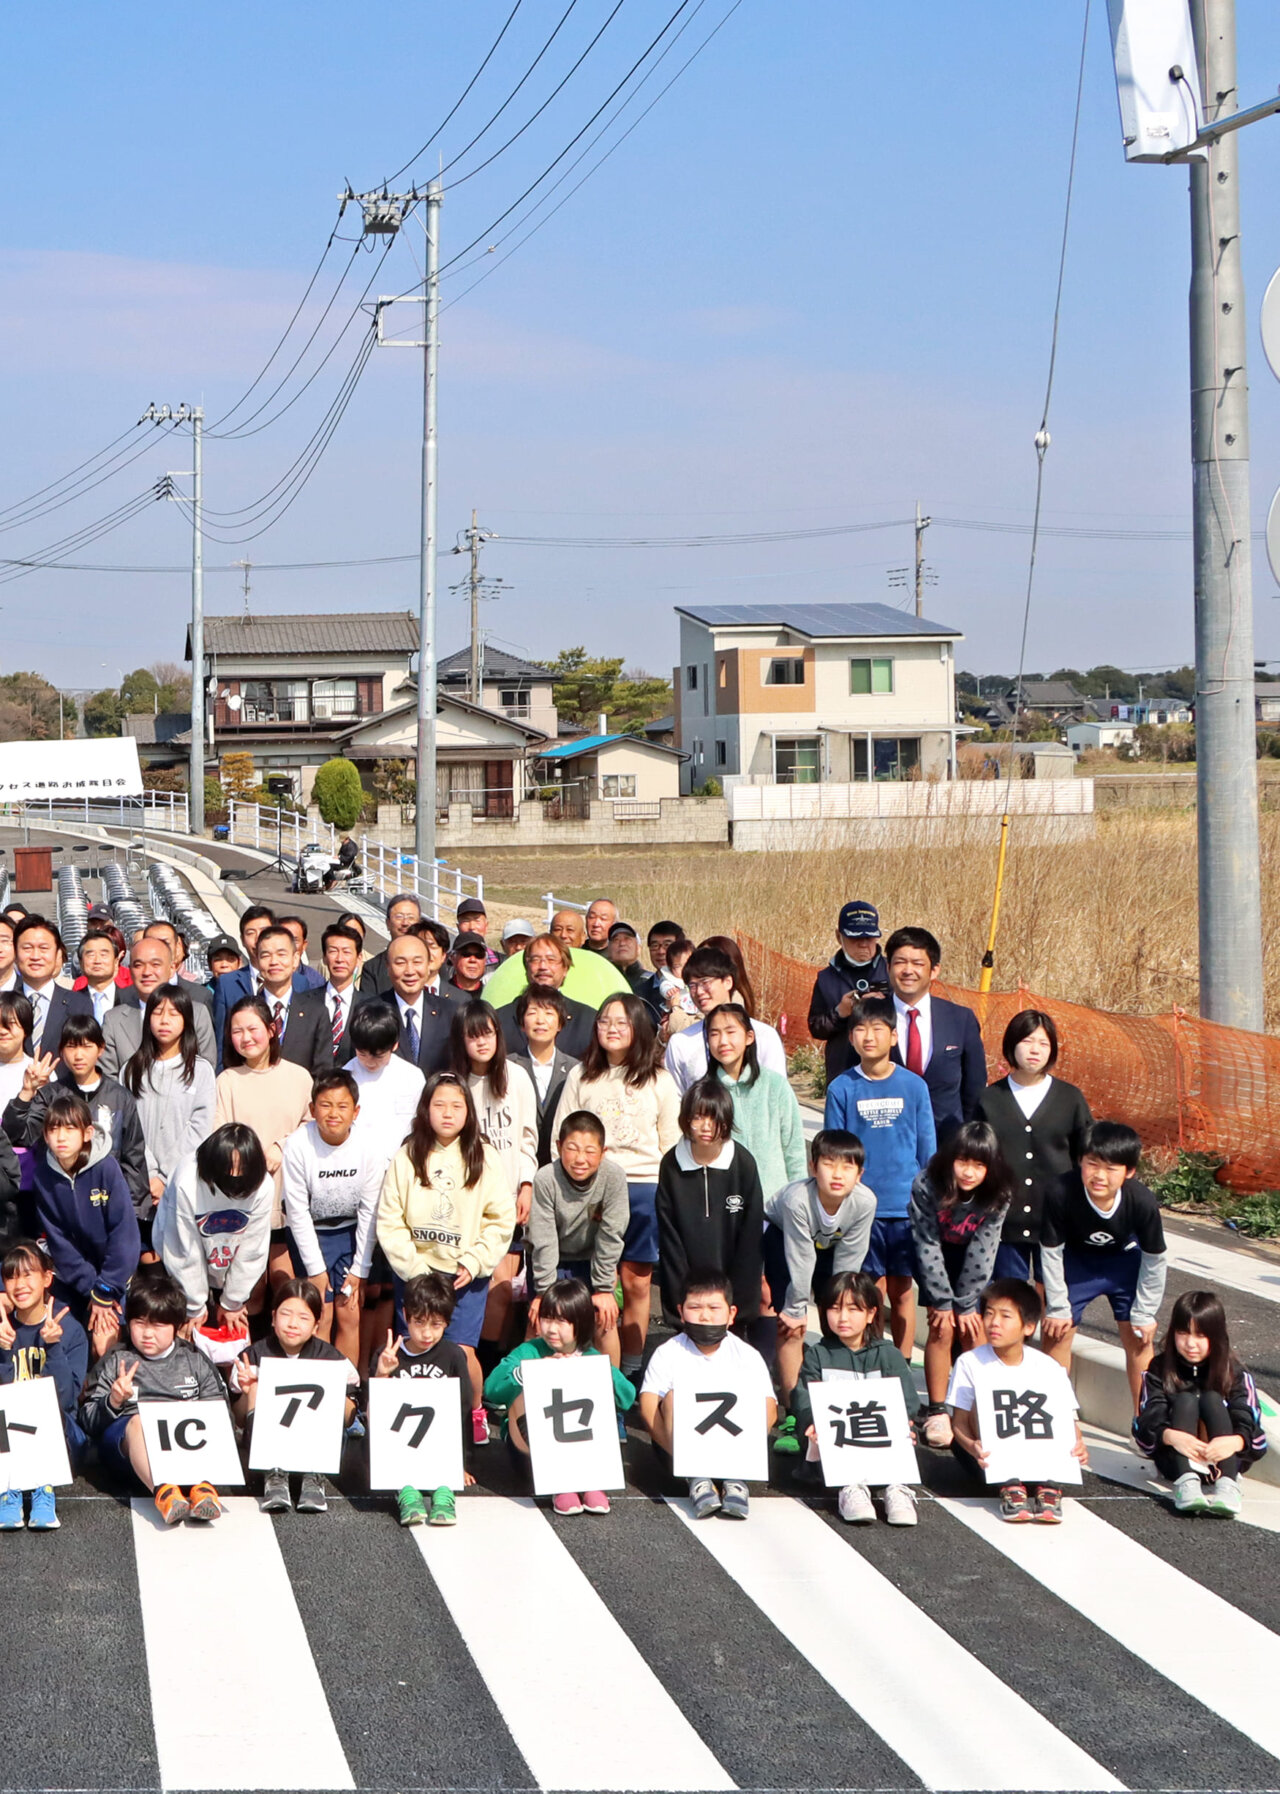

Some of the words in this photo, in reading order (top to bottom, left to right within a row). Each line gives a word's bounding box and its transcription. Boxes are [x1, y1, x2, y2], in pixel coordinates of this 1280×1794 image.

[318, 1168, 358, 1179] DWNLD
[413, 1229, 462, 1247] SNOOPY
[274, 1383, 325, 1428] ア
[390, 1402, 435, 1449] ク
[543, 1388, 594, 1443] セ
[694, 1391, 743, 1437] ス
[828, 1400, 892, 1449] 道
[992, 1389, 1054, 1440] 路
[157, 1418, 207, 1451] IC
